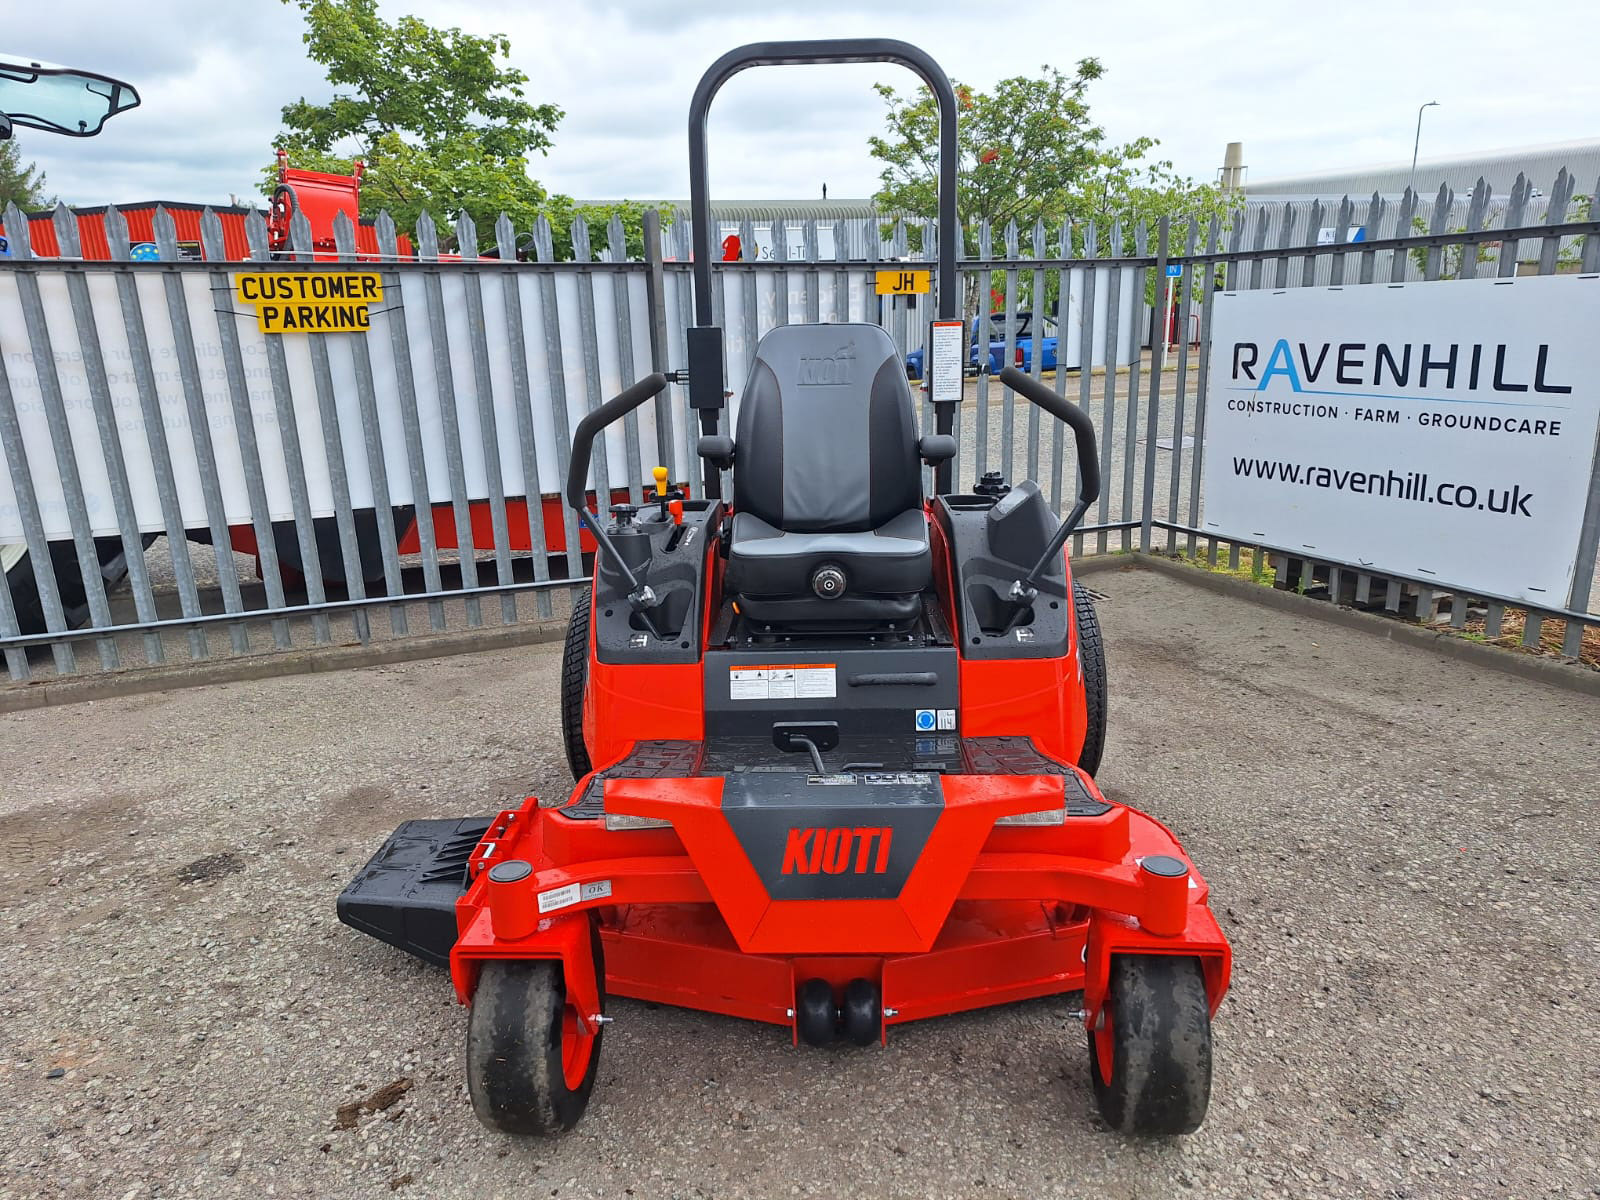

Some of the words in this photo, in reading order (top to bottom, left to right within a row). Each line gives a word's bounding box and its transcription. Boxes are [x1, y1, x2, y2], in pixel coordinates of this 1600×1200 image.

[242, 276, 377, 300] CUSTOMER
[892, 273, 914, 291] JH
[263, 305, 369, 329] PARKING
[1232, 338, 1573, 394] RAVENHILL
[1227, 399, 1339, 419] CONSTRUCTION
[1354, 408, 1400, 424] FARM
[1418, 412, 1562, 436] GROUNDCARE
[1233, 456, 1534, 517] www.ravenhill.co.uk
[781, 826, 893, 875] KIOTI
[588, 884, 604, 895] OK
